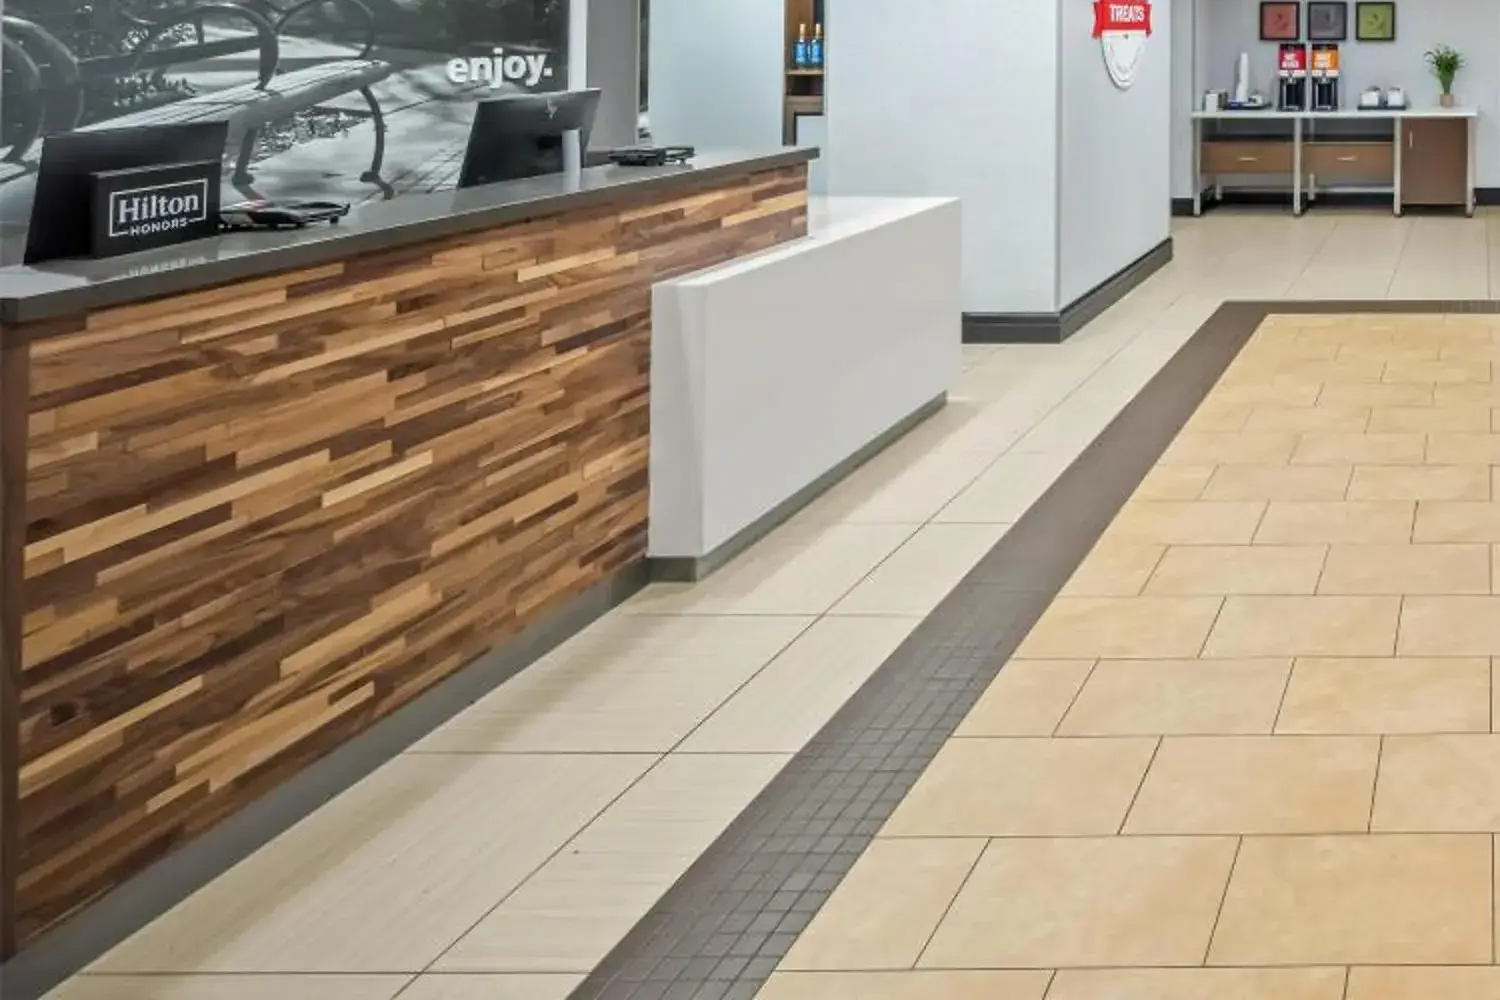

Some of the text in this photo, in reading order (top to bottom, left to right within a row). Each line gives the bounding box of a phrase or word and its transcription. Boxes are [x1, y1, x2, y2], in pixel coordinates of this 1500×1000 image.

[1109, 4, 1145, 23] TREATS
[446, 47, 553, 88] enjoy.
[118, 194, 199, 224] Hilton
[130, 217, 188, 237] HONORS
